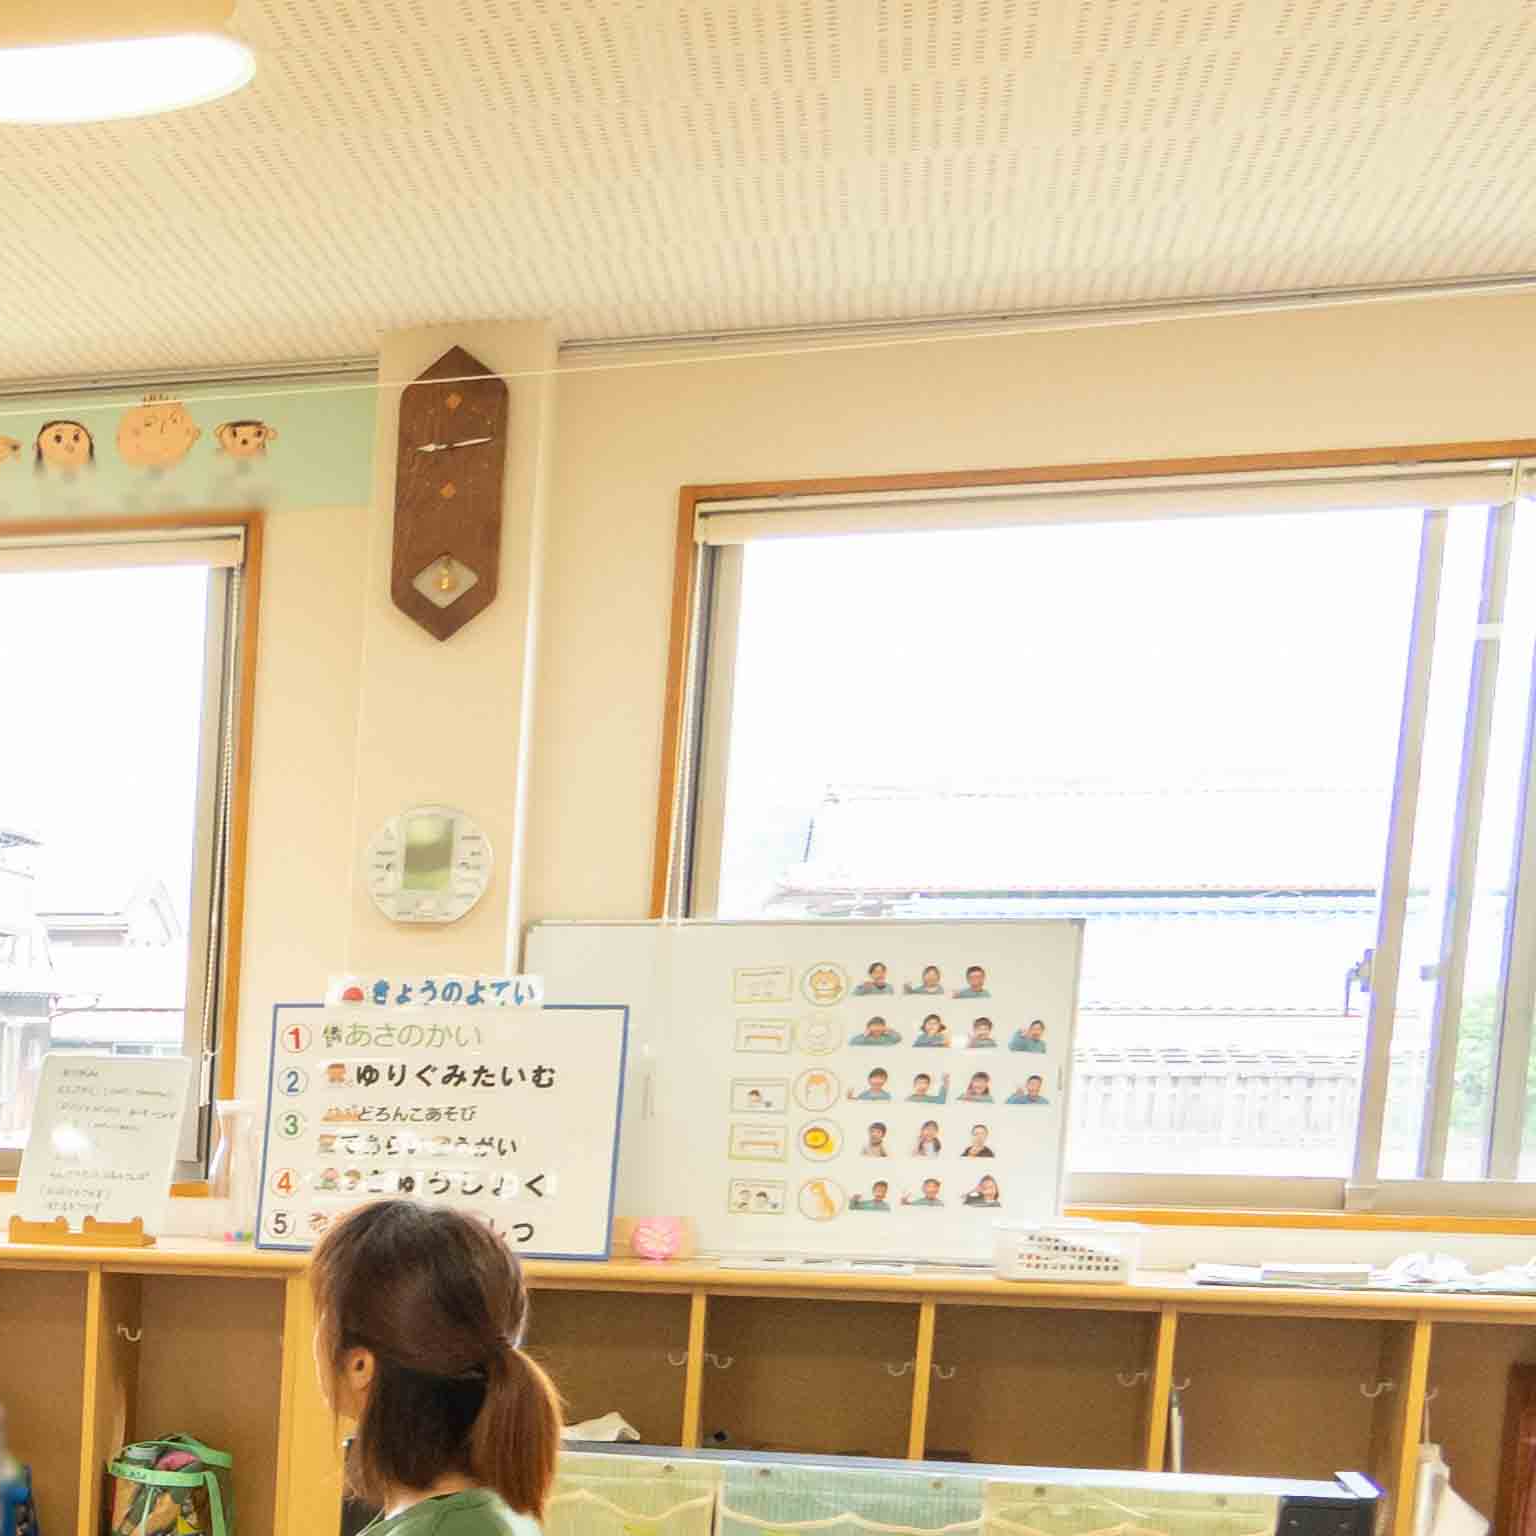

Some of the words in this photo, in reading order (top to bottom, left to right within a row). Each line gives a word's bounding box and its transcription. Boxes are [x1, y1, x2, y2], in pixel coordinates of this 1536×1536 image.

[372, 979, 536, 1006] きょうのよてい
[344, 1023, 482, 1048] あさのかい
[356, 1063, 556, 1089] ゆりぐみたいむ
[357, 1105, 478, 1123] どろんこあそび
